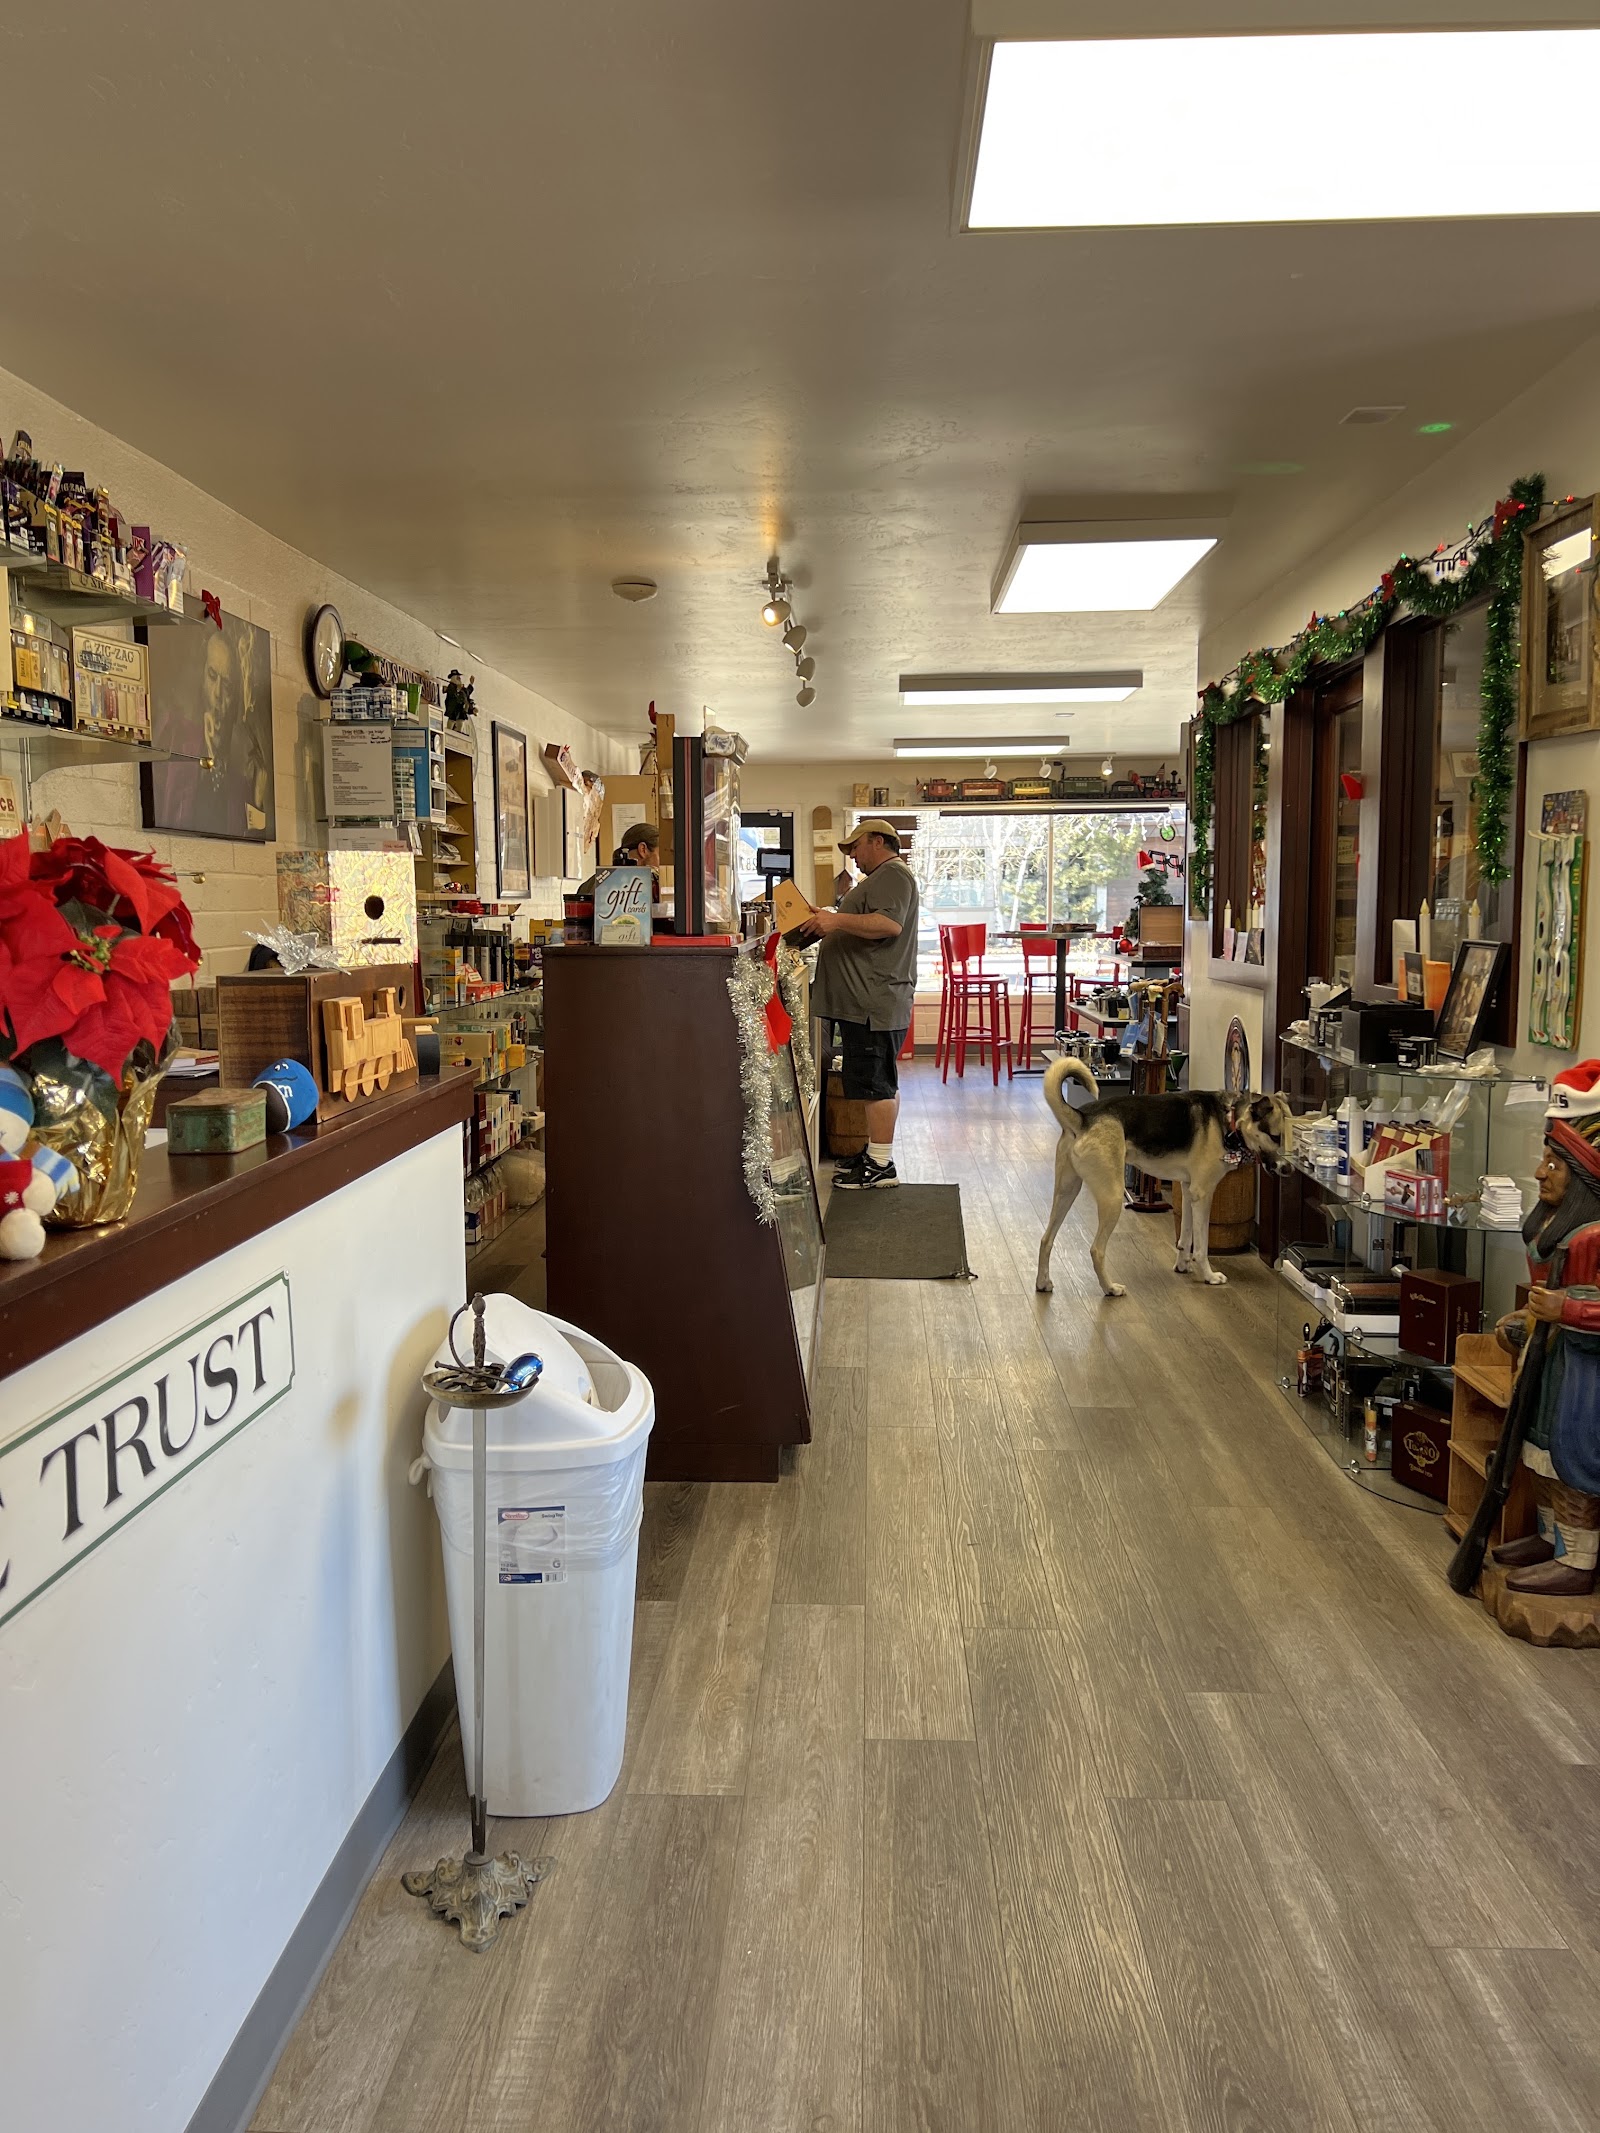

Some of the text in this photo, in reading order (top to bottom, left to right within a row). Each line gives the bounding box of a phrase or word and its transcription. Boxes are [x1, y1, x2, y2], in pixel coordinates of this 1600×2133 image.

[94, 643, 134, 663] ZIG-ZAG
[0, 797, 15, 812] CB
[599, 877, 643, 919] gift
[628, 902, 647, 913] cards
[39, 1305, 275, 1542] TRUST
